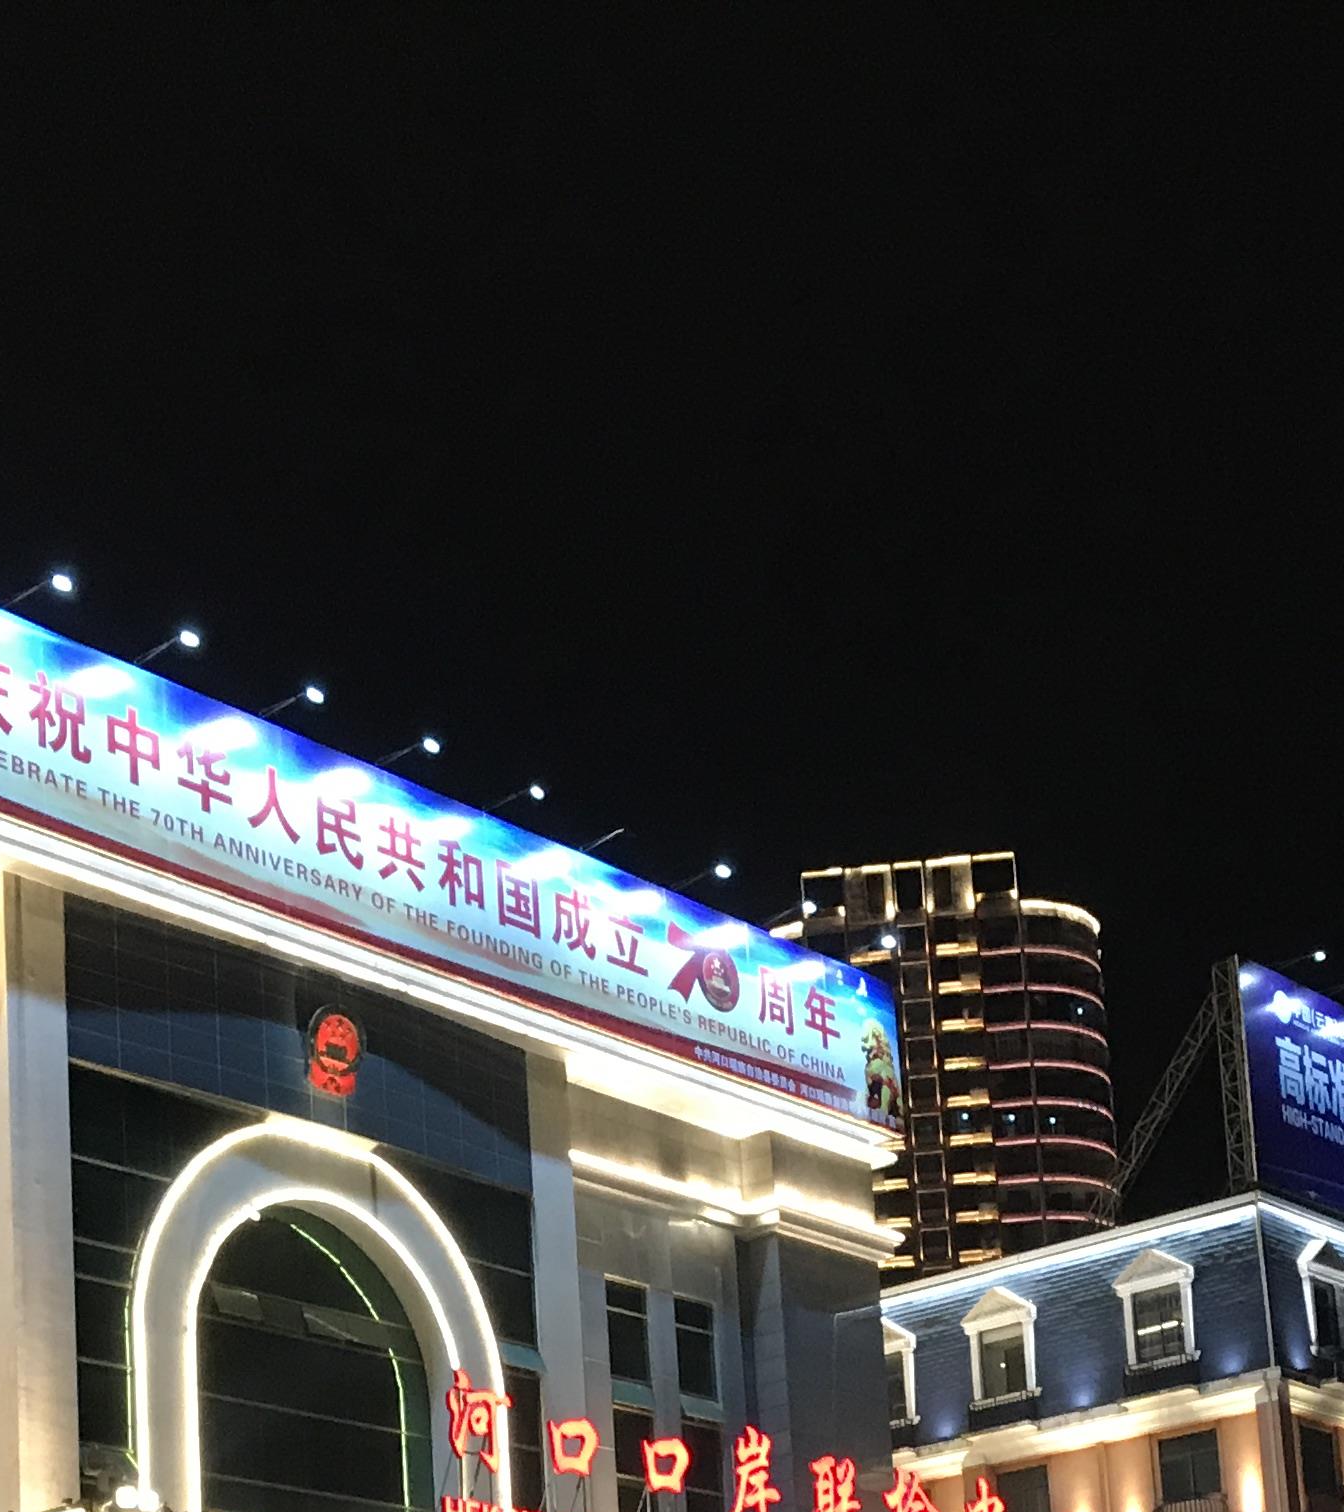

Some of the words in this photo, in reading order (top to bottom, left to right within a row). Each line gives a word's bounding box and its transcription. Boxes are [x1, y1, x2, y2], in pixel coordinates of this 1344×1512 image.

[97, 786, 141, 819] THE
[150, 807, 205, 844] 70TH
[213, 832, 363, 902] ANNIVERSARY
[371, 891, 397, 914] OF
[402, 902, 439, 932] THE
[446, 918, 545, 970] FOUNDING
[550, 958, 574, 980] OF
[579, 969, 610, 997] THE
[617, 984, 693, 1025] PEOPLE'S
[698, 1014, 772, 1056] REPUBLIC
[776, 1043, 796, 1062] OF
[800, 1052, 846, 1082] CHINA
